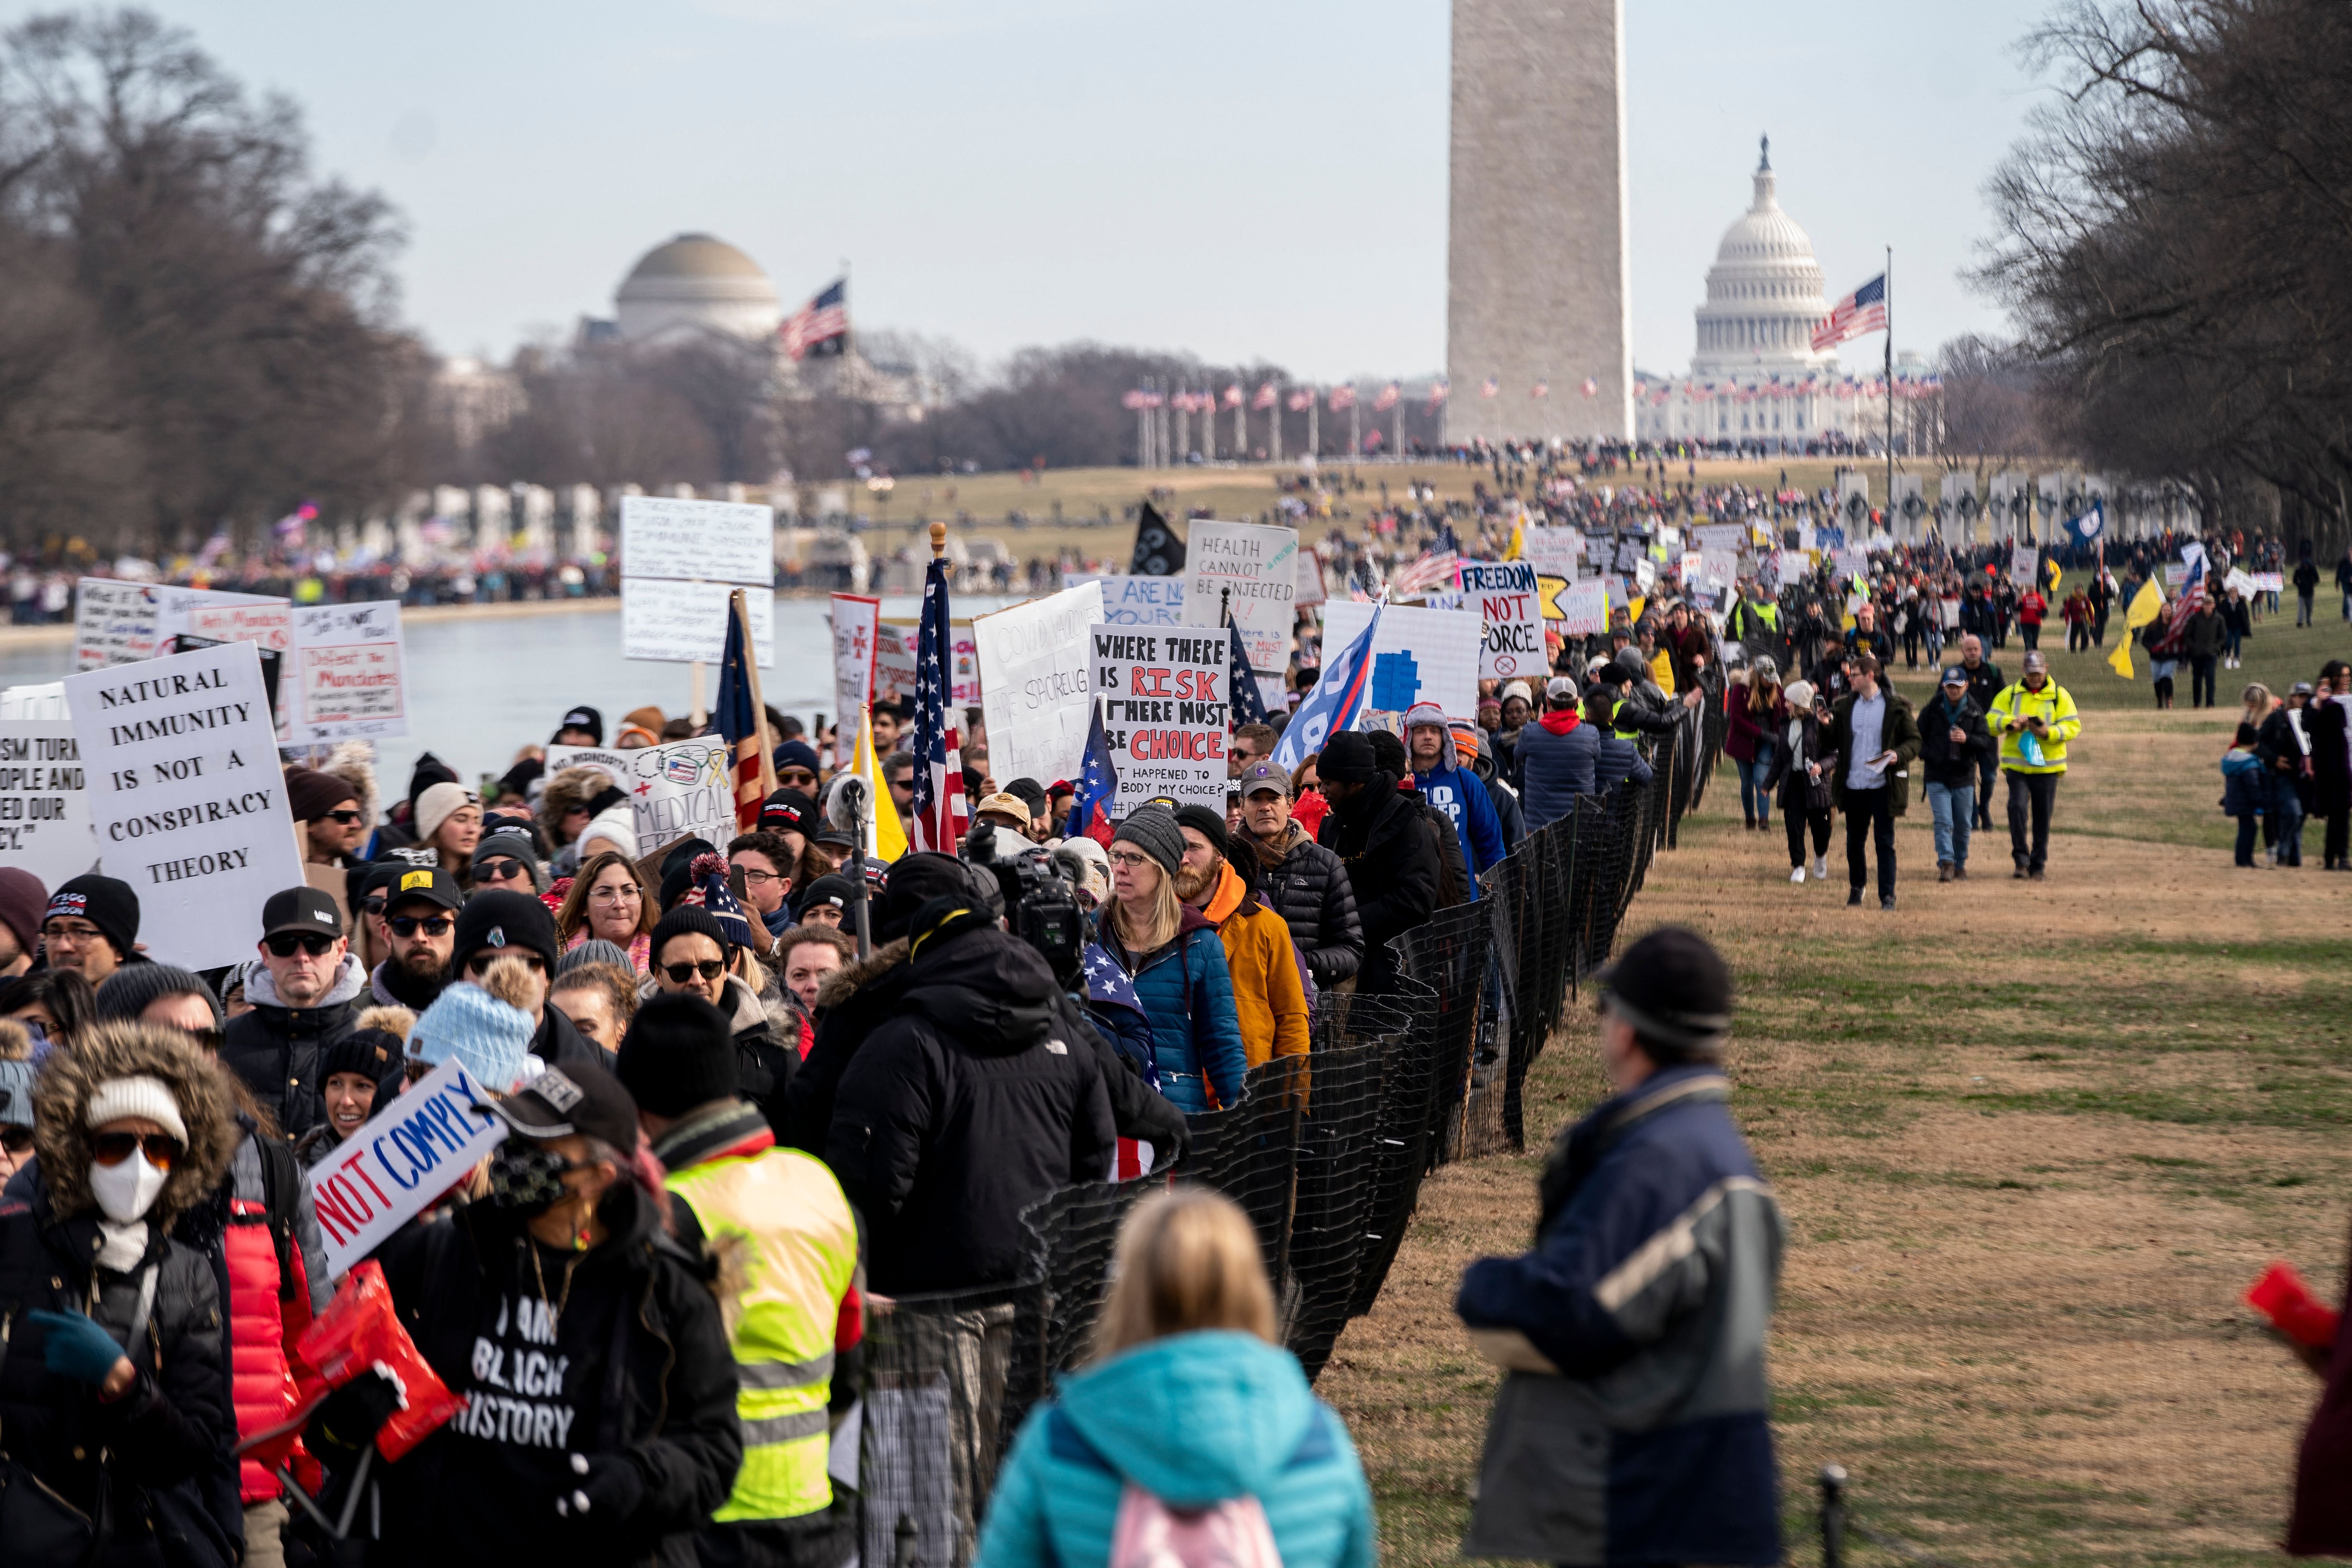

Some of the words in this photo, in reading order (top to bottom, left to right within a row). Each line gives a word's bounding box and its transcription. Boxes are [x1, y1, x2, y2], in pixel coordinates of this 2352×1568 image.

[1202, 538, 1260, 558] HEALTH
[1200, 560, 1262, 576] CANNOT
[1461, 564, 1539, 595] FREEDOM
[1122, 579, 1162, 604] ARE
[1197, 578, 1214, 594] BE
[1225, 580, 1293, 601] INJECTED
[1483, 590, 1530, 623] NOT
[997, 620, 1047, 663] COVID
[1051, 605, 1103, 644] VACCINES
[1095, 634, 1156, 662] WHERE
[1165, 637, 1225, 665] THERE
[1239, 628, 1264, 638] here
[1270, 629, 1280, 639] is
[1257, 641, 1283, 651] MUST
[1488, 621, 1539, 655] ORCE
[99, 668, 228, 710] NATURAL
[992, 691, 1018, 721] ARE
[1025, 668, 1090, 709] SACRELIG
[1100, 666, 1119, 688] IS
[1131, 666, 1219, 702] RISK
[110, 702, 251, 746] IMMUNITY
[1107, 699, 1173, 722] THERE
[1179, 701, 1228, 727] MUST
[998, 739, 1053, 781] AGAINST
[1058, 732, 1082, 760] GOD
[1105, 729, 1126, 751] BE
[1130, 729, 1225, 761] CHOICE
[48, 767, 85, 790] AND
[110, 769, 139, 791] IS
[153, 756, 204, 783] NOT
[226, 749, 245, 769] A
[1133, 768, 1188, 780] HAPPENED
[1194, 770, 1210, 780] TO
[1121, 782, 1151, 794] BODY
[1158, 784, 1176, 795] MY
[1179, 783, 1225, 798] CHOICE?
[30, 797, 67, 820] OUR
[109, 789, 272, 842] CONSPIRACY
[633, 783, 732, 835] MEDICAL
[146, 847, 250, 884] THEORY
[316, 1147, 394, 1248] NOT
[372, 1070, 496, 1191] COMPLY
[495, 1292, 509, 1337] I
[516, 1294, 558, 1346] AM
[449, 1388, 576, 1450] HISTORY
